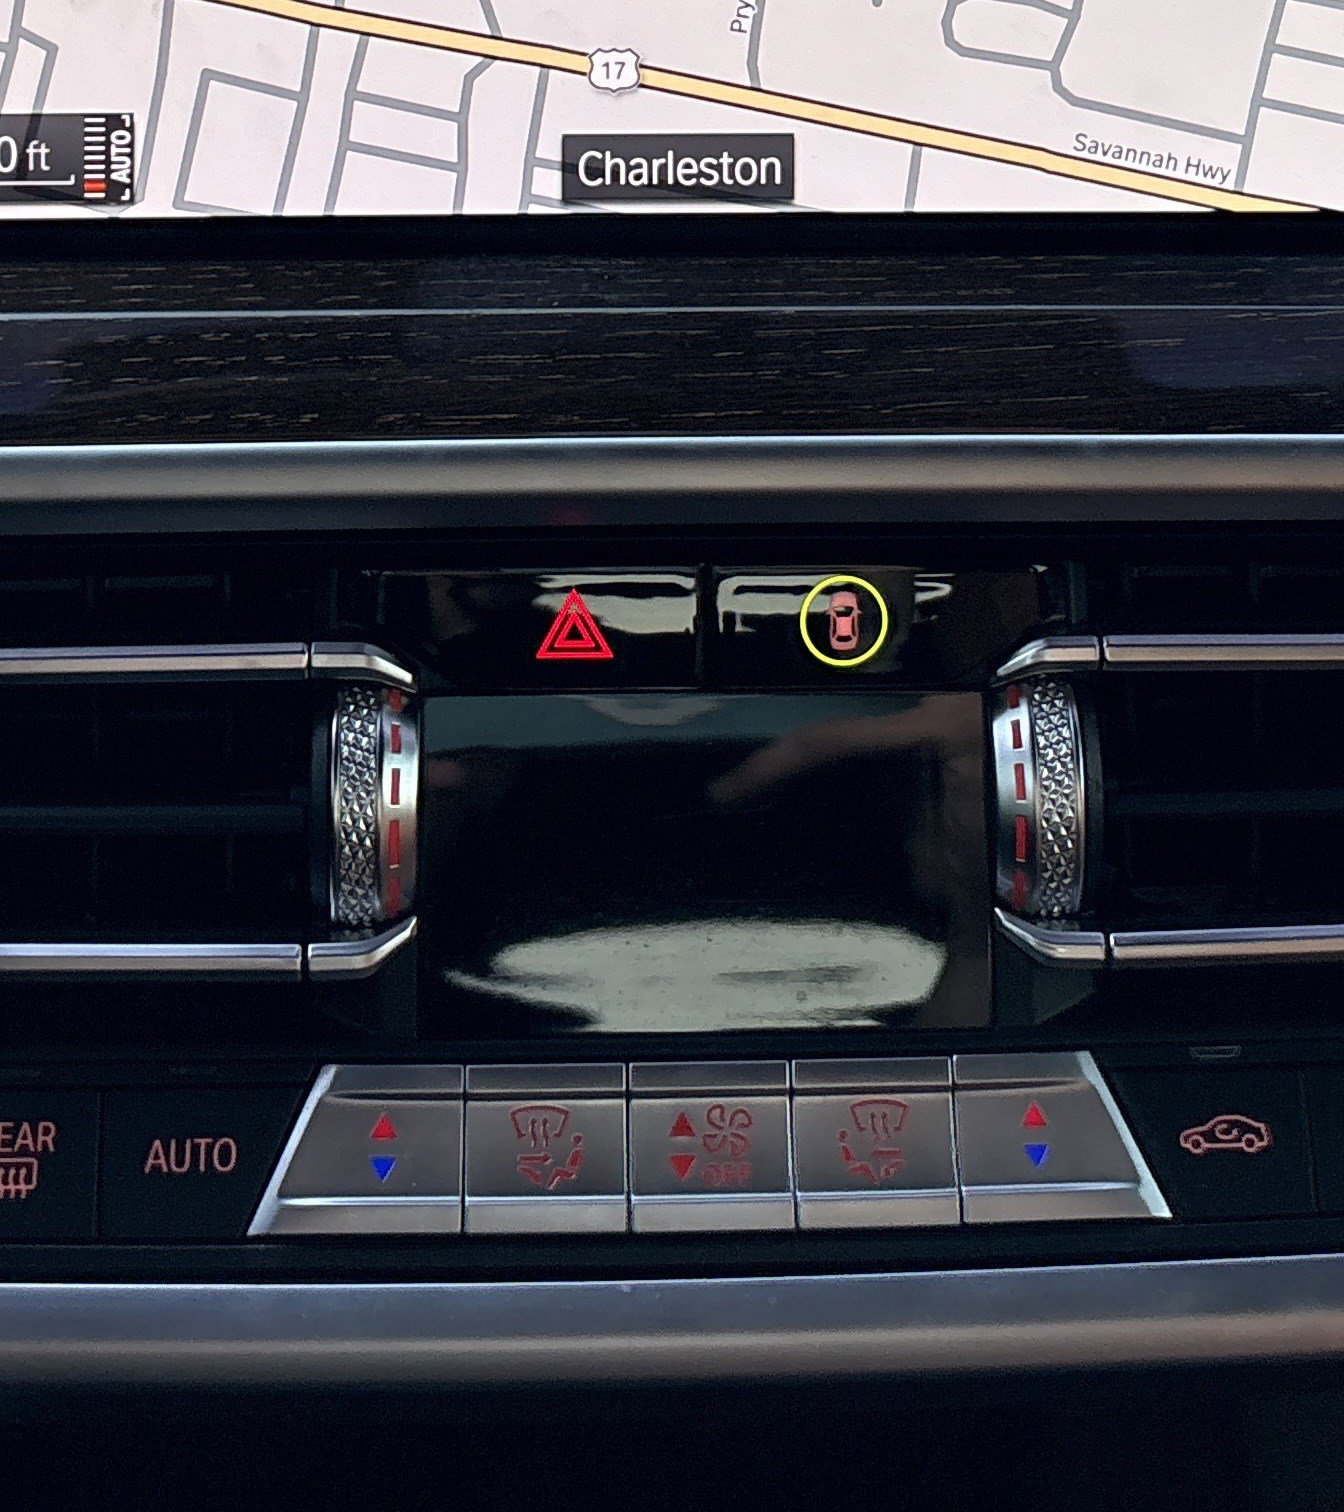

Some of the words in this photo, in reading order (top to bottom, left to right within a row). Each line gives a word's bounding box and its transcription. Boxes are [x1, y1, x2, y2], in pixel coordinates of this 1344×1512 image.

[601, 61, 625, 80] 17
[26, 139, 51, 171] ft
[110, 129, 132, 184] AUTO
[577, 149, 782, 186] Charleston
[1072, 133, 1178, 172] Savannah
[1184, 156, 1232, 185] Hwy
[145, 1137, 237, 1173] AUTO
